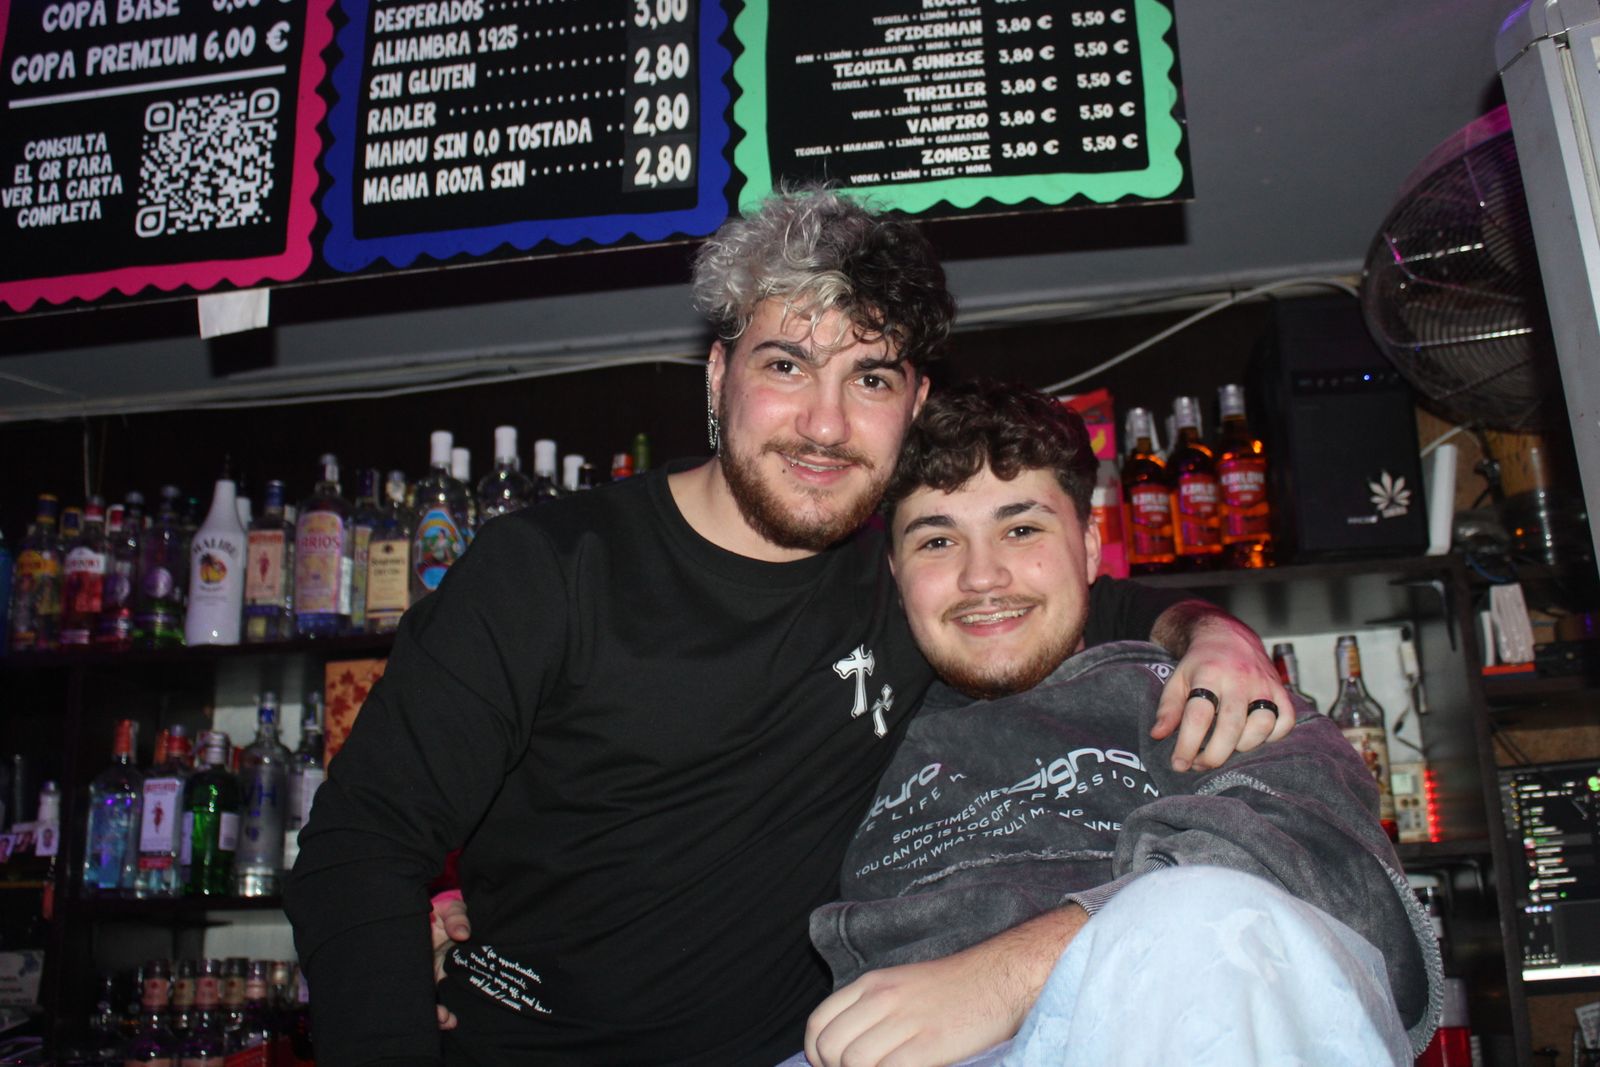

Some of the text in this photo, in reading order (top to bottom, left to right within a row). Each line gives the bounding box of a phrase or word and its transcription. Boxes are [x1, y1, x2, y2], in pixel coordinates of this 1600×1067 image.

[42, 0, 107, 32] COPA
[116, 0, 180, 24] BASE
[374, 0, 485, 33] DESPERADOS
[634, 0, 688, 30] 3,00
[885, 8, 1126, 43] SPIDERMAN 3,80 € 5,50 €
[11, 21, 290, 85] COPA PREMIUM 6,00 €
[372, 24, 518, 66] ALHAMBRA 1925
[833, 39, 1129, 78] TEQUILA SUNRISE 3,80 € 5,50 €
[369, 62, 476, 100] SIN GLUTEN
[634, 43, 690, 86] 2,80
[903, 70, 1132, 102] THRILLER 3,80 € 5,50 €
[367, 102, 436, 135] RADLER
[633, 93, 689, 137] 2,80
[906, 101, 1135, 134] VAMPIRO 3,80 € 5,50 €
[24, 132, 107, 161] CONSULTA
[365, 117, 592, 170] MAHOU SIN 0,0 TOSTADA
[921, 133, 1138, 165] ZOMBIE 3,80 € 5,50 €
[14, 153, 112, 184] EL QR PARA
[363, 160, 525, 205] MAGNA ROJA SIN
[634, 144, 692, 188] 2,80
[1, 174, 123, 208] VER LA CARTA
[17, 199, 101, 228] COMPLETA
[892, 789, 1001, 844] SOMETIMES THE
[855, 861, 880, 879] YOU
[882, 844, 911, 867] CAN
[913, 834, 933, 851] DO
[937, 828, 952, 839] IS
[957, 816, 990, 833] LOG
[991, 799, 1013, 822] OFF
[930, 833, 977, 858] WHAT
[981, 813, 1027, 837] TRULY
